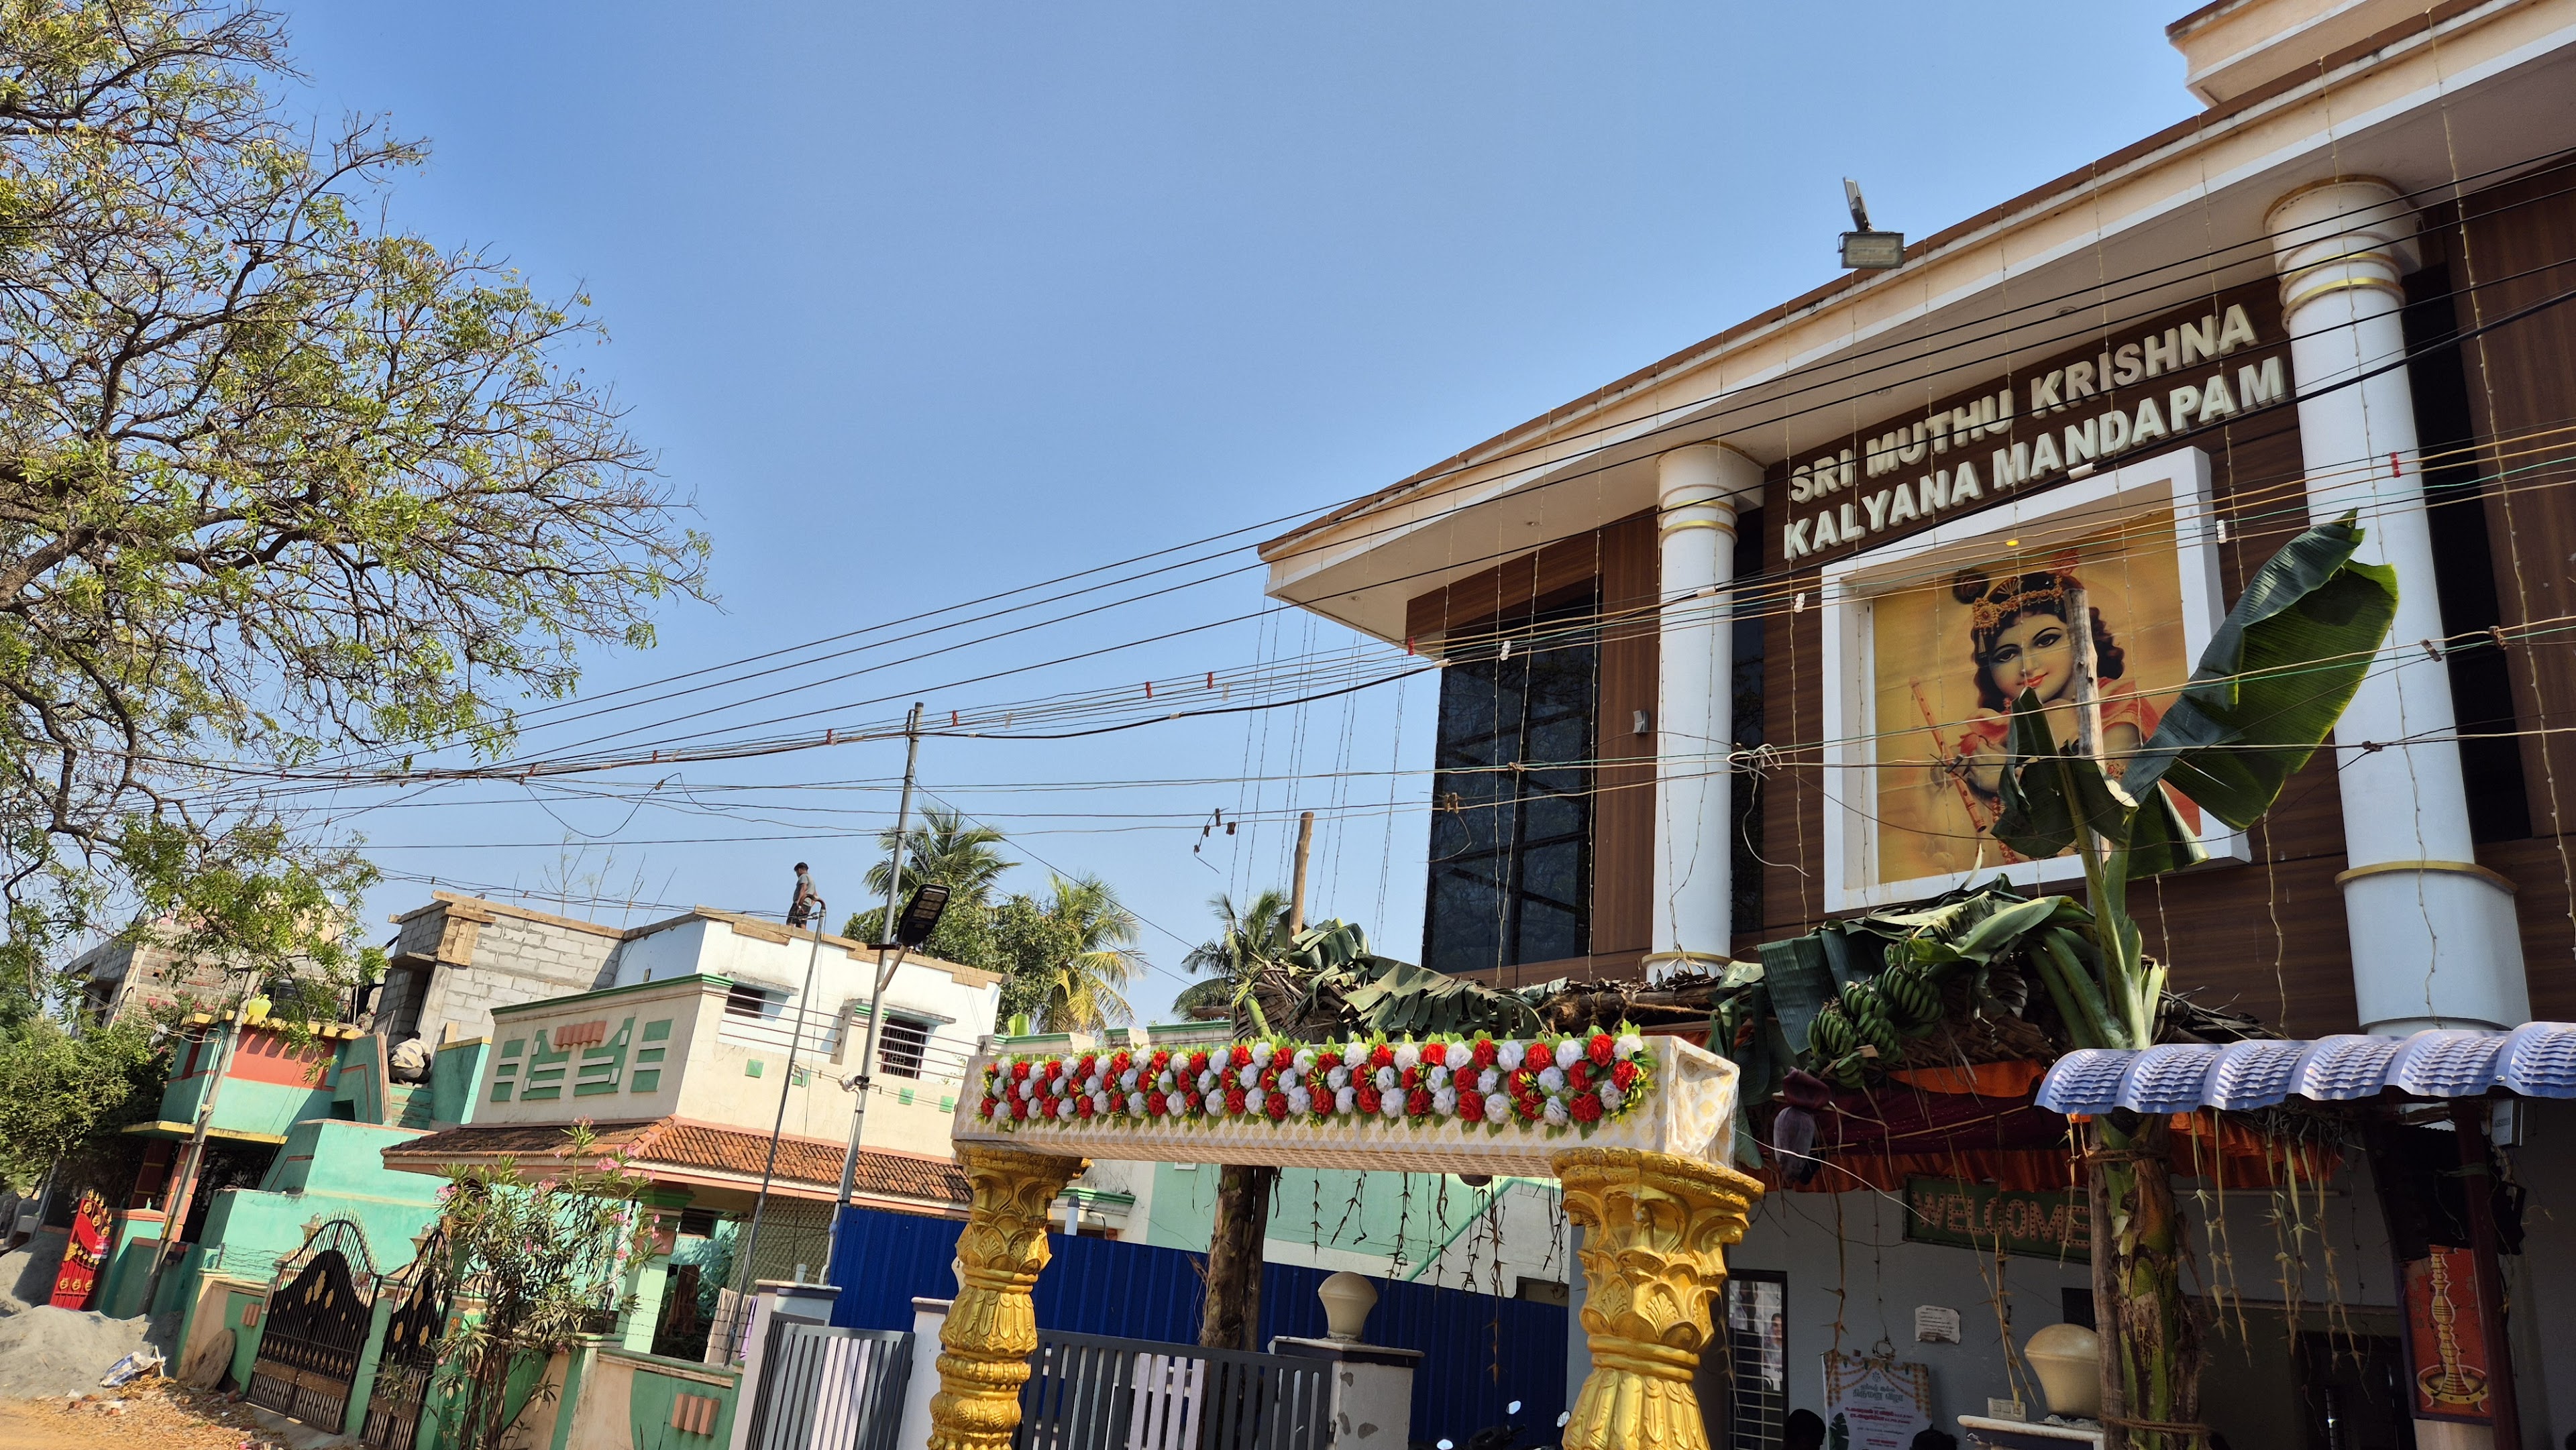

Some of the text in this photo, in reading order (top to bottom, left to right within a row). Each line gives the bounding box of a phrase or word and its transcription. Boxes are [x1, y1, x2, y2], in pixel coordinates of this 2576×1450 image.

[1783, 355, 2286, 561] KALYANA MANDAPAM
[1789, 303, 2259, 504] SRI MUTHU KRISHNA
[1912, 1190, 2090, 1250] WELCOME
